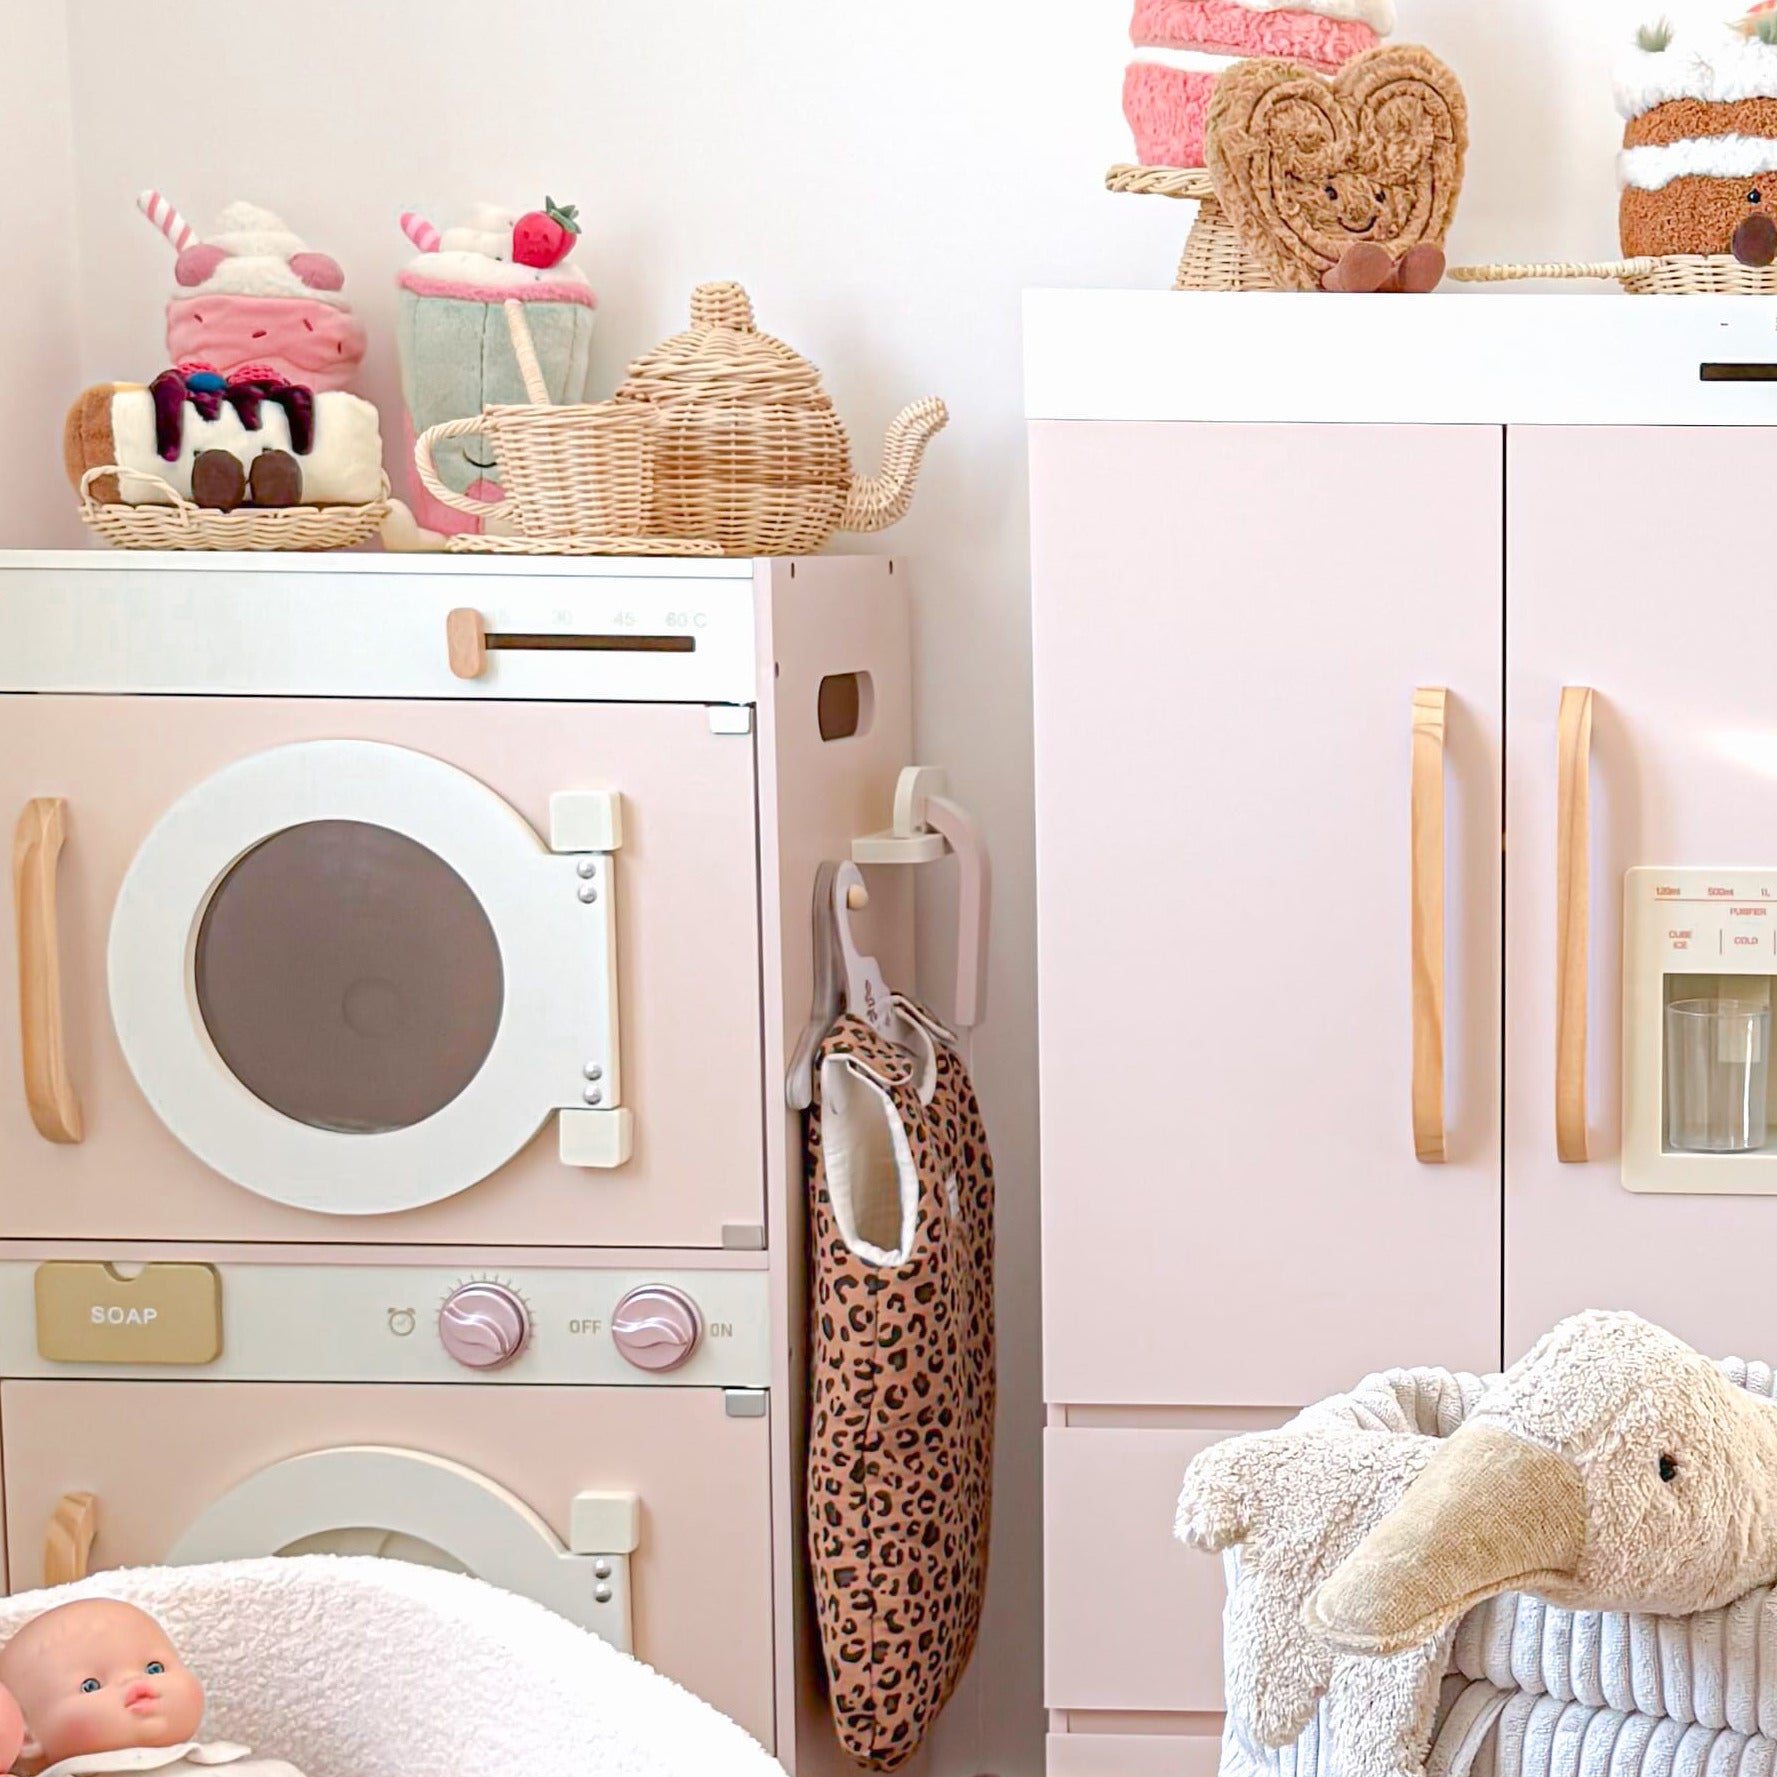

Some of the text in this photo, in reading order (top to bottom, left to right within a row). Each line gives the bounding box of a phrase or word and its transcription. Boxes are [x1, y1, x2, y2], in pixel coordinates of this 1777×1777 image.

[1672, 940, 1688, 950] ICE
[1733, 936, 1759, 946] COLD
[90, 1305, 158, 1326] SOAP
[568, 1319, 602, 1336] OFF
[709, 1322, 734, 1339] ON
